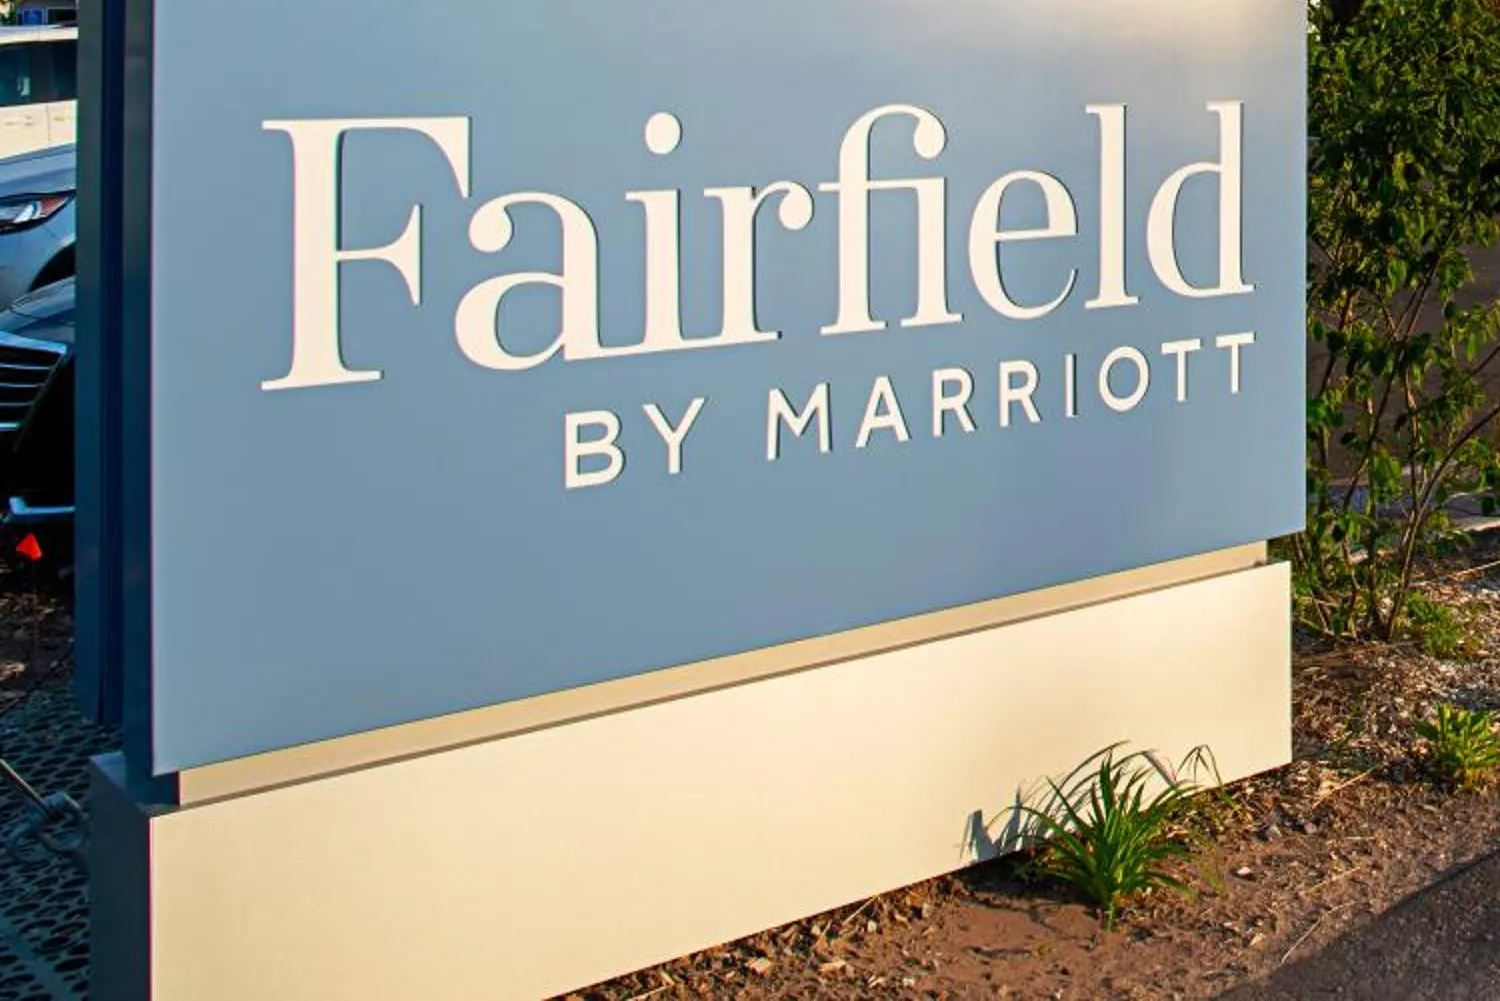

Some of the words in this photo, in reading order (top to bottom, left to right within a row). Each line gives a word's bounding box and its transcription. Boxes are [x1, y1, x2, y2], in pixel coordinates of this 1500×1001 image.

[261, 101, 1256, 391] Fairfield
[564, 397, 708, 489] BY
[766, 331, 1257, 460] MARRIOTT
